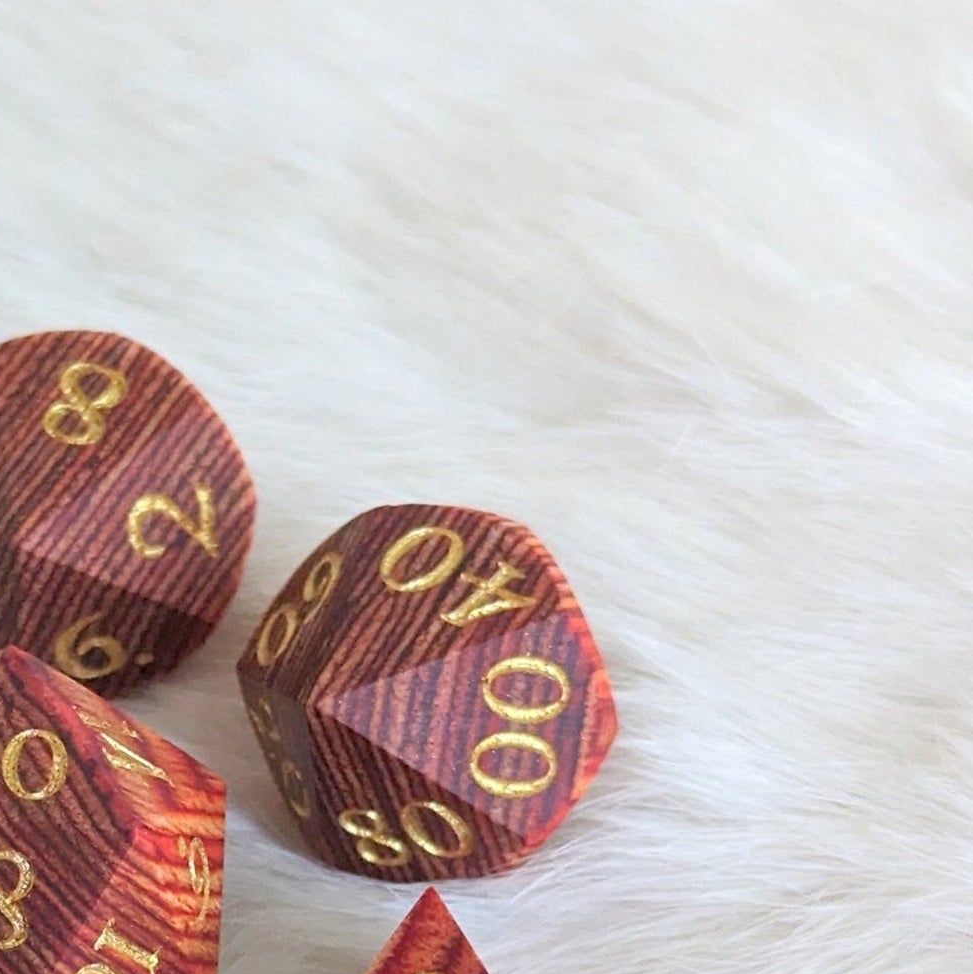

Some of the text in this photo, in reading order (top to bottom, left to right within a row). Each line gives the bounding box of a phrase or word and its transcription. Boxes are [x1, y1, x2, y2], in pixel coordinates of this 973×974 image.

[42, 363, 126, 445] 8
[129, 480, 218, 559] 2
[380, 526, 536, 627] 40
[469, 657, 571, 797] 00
[338, 801, 474, 866] 80
